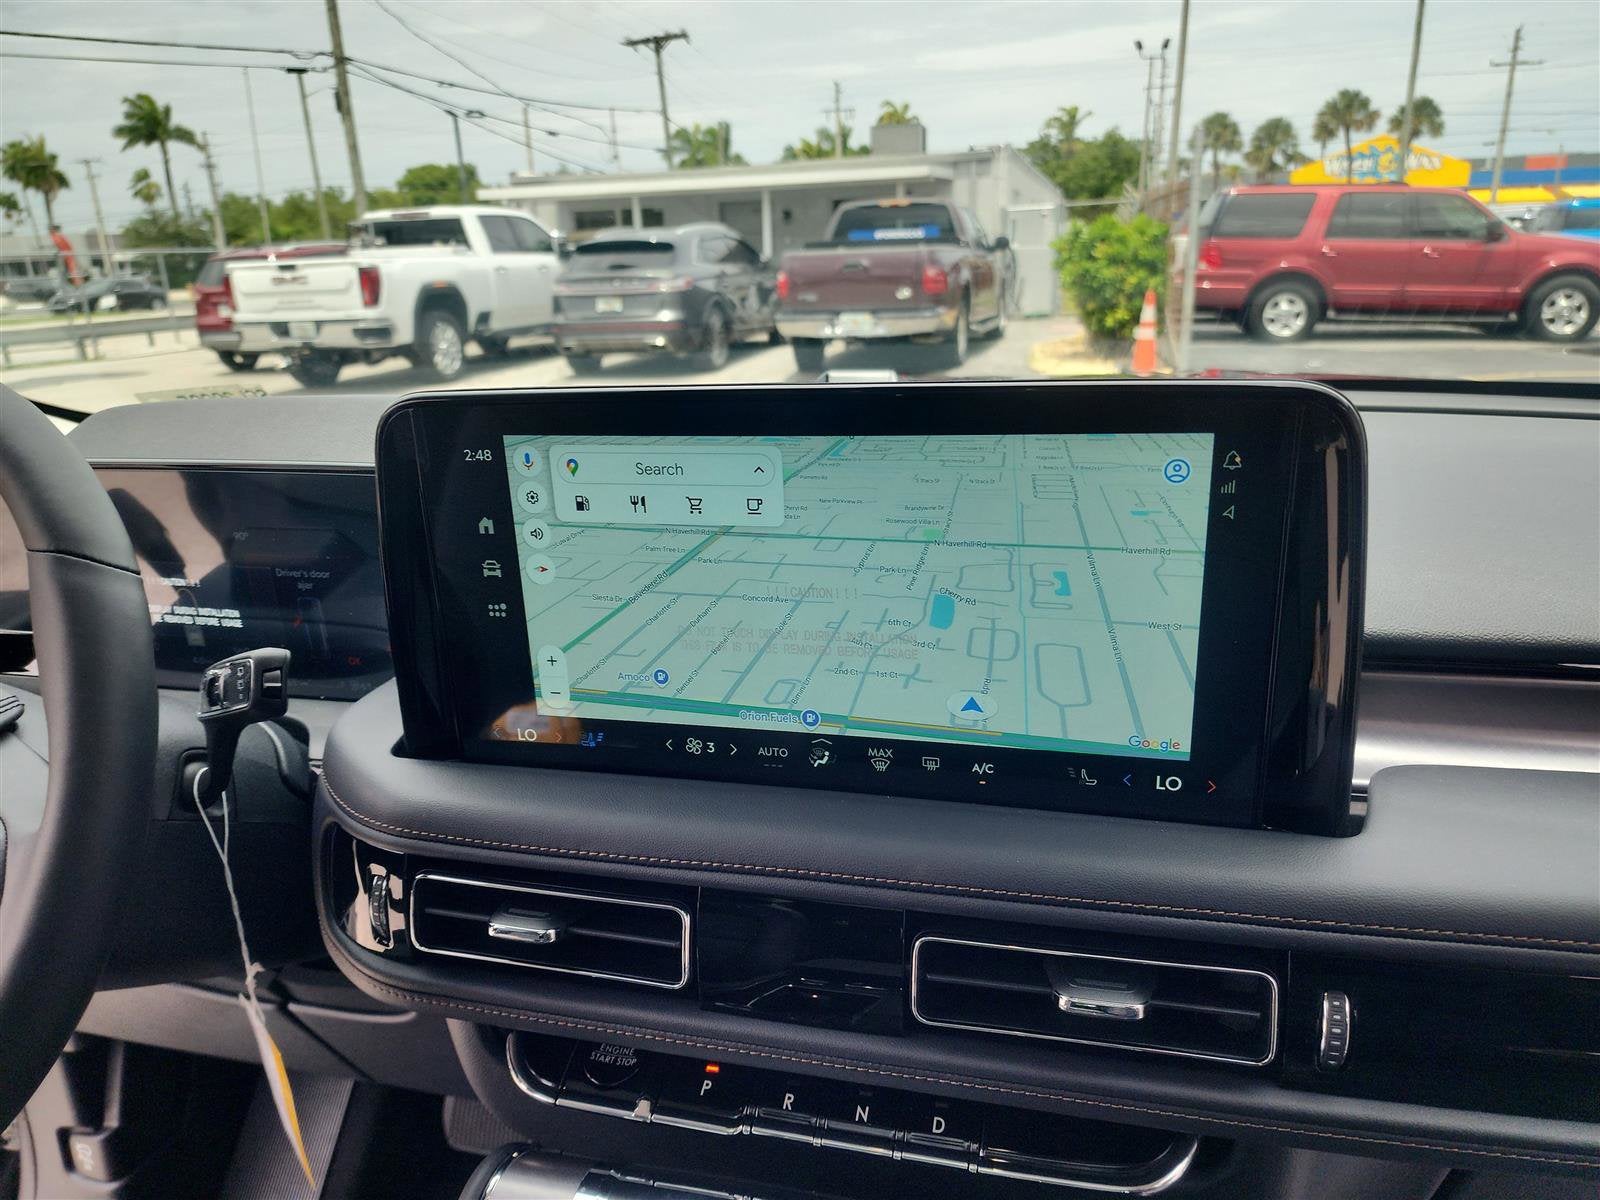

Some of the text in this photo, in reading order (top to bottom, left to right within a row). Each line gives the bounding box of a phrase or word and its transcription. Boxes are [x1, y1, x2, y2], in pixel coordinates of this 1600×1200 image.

[463, 449, 493, 461] 2:48
[635, 462, 684, 476] Search
[885, 518, 917, 526] Rosewood
[672, 527, 700, 536] Haverhill
[942, 540, 976, 548] Haverhill
[1121, 546, 1171, 556] Haverhill Rd
[697, 556, 712, 565] Park
[275, 567, 330, 579] Driver's door
[879, 566, 896, 574] Park
[592, 593, 614, 602] Siesta
[741, 593, 789, 604] Concord Ave
[939, 586, 977, 606] Cherry Rd
[645, 602, 671, 626] Charlotte
[689, 604, 713, 629] Durham
[887, 618, 912, 628] 6th Ct
[1147, 621, 1171, 631] West
[911, 639, 926, 648] 3rd
[836, 647, 873, 657] BEFOR
[575, 662, 600, 686] Charlotte
[617, 671, 651, 682] Amoco
[833, 667, 859, 676] 2nd Ct
[875, 670, 899, 679] 1st Ct
[740, 709, 798, 724] Orion Fuels
[517, 728, 537, 742] LO
[706, 742, 715, 753] 3
[1128, 735, 1181, 752] Google
[758, 746, 789, 758] AUTO
[867, 747, 893, 759] MAX
[971, 762, 994, 775] A/C
[1156, 775, 1183, 792] LO
[600, 1042, 636, 1057] ENGINE
[589, 1051, 637, 1067] START STOP
[700, 1080, 712, 1097] P
[782, 1092, 795, 1111] R
[855, 1104, 870, 1124] N
[932, 1116, 946, 1134] D
